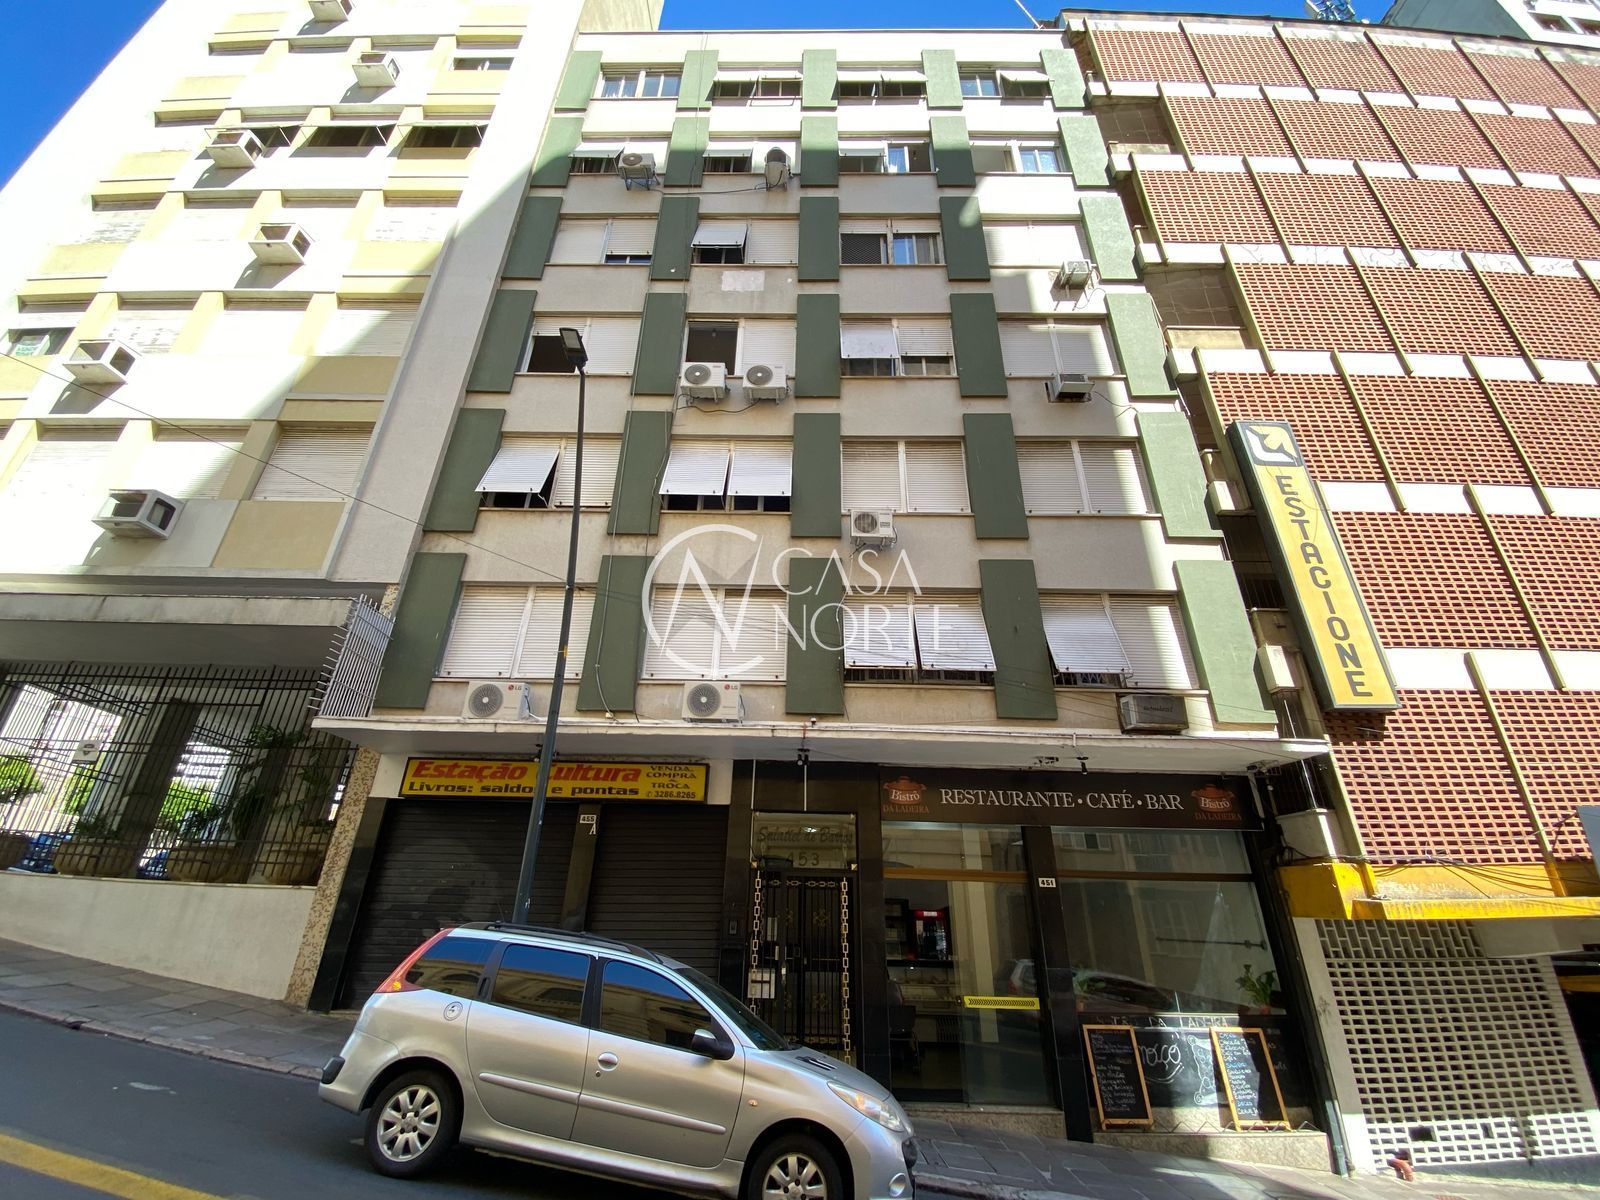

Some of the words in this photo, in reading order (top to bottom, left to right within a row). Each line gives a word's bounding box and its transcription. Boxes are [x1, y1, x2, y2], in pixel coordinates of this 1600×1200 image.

[1275, 475, 1373, 697] ESTACIONE
[412, 761, 528, 783] Estação
[408, 781, 473, 793] Livros:
[479, 784, 535, 794] saldo
[551, 786, 563, 794] e
[571, 786, 640, 796] pontas
[651, 782, 690, 790] TROCA
[939, 789, 1075, 808] RESTAURANTE
[1086, 789, 1135, 809] CAFÉ
[1144, 794, 1184, 810] BAR
[589, 823, 597, 835] A
[787, 850, 820, 867] 453
